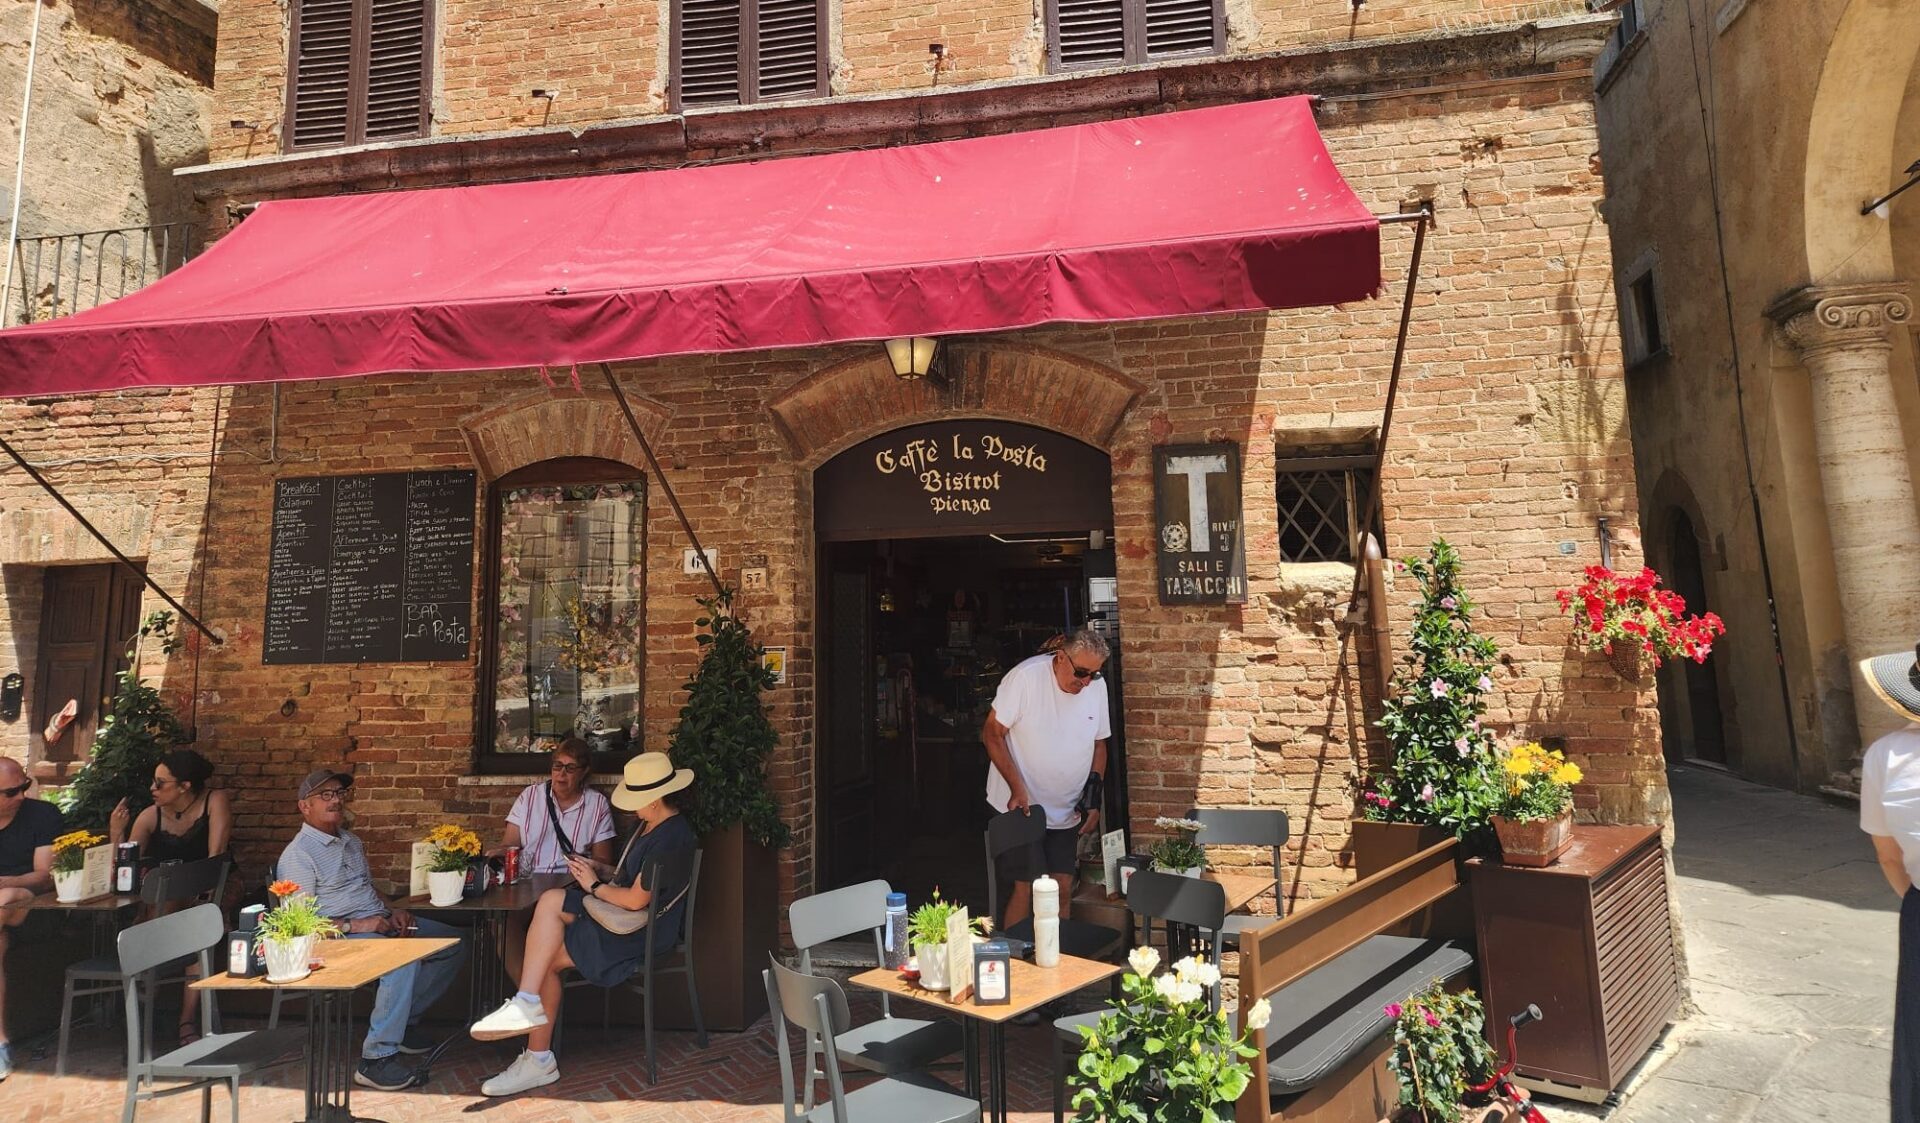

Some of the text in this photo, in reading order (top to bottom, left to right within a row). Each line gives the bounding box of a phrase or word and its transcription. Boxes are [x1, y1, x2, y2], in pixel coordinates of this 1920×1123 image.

[876, 433, 1048, 475] Caffè la Posta
[919, 469, 1004, 493] Bistrot
[1165, 455, 1228, 553] T
[1178, 559, 1225, 573] SALI E
[746, 572, 761, 584] 57
[1164, 577, 1242, 596] TABACCHI
[407, 602, 443, 621] BAR
